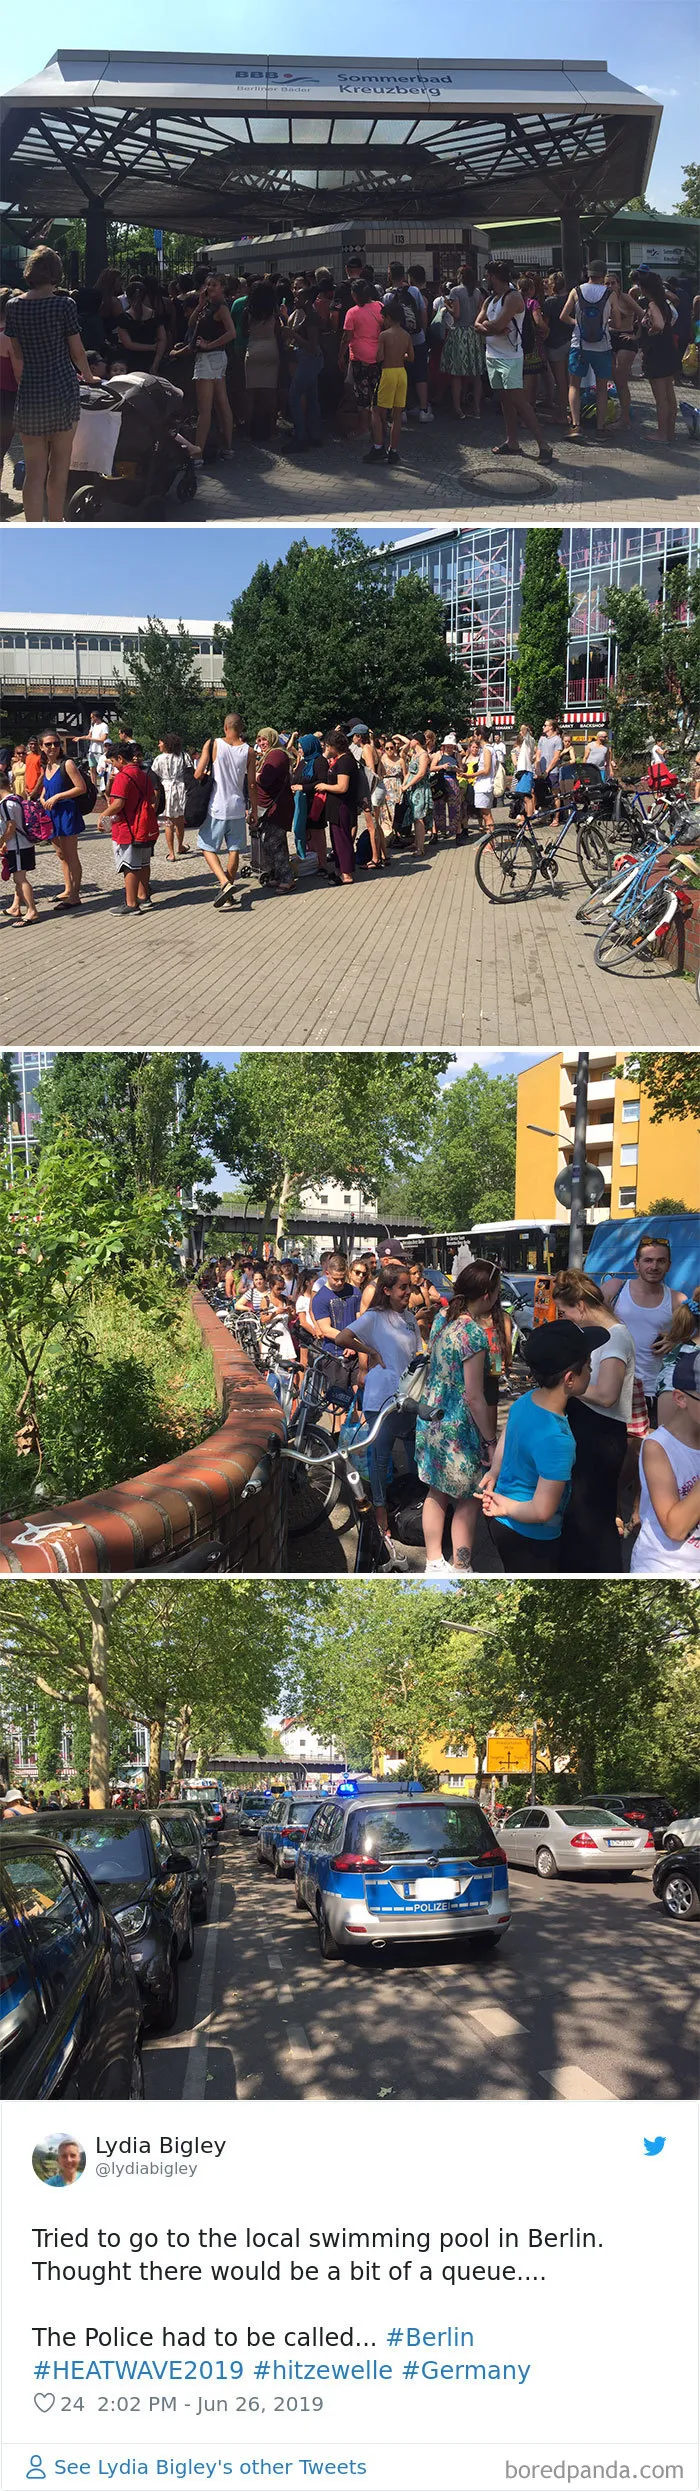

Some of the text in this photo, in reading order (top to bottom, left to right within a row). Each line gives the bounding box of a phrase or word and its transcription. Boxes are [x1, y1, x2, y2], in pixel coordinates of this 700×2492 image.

[235, 71, 279, 79] BBB
[336, 73, 453, 84] Sommerbad
[339, 84, 441, 97] Kreuzberg
[394, 235, 405, 244] 113
[414, 1902, 451, 1912] POLIZEI
